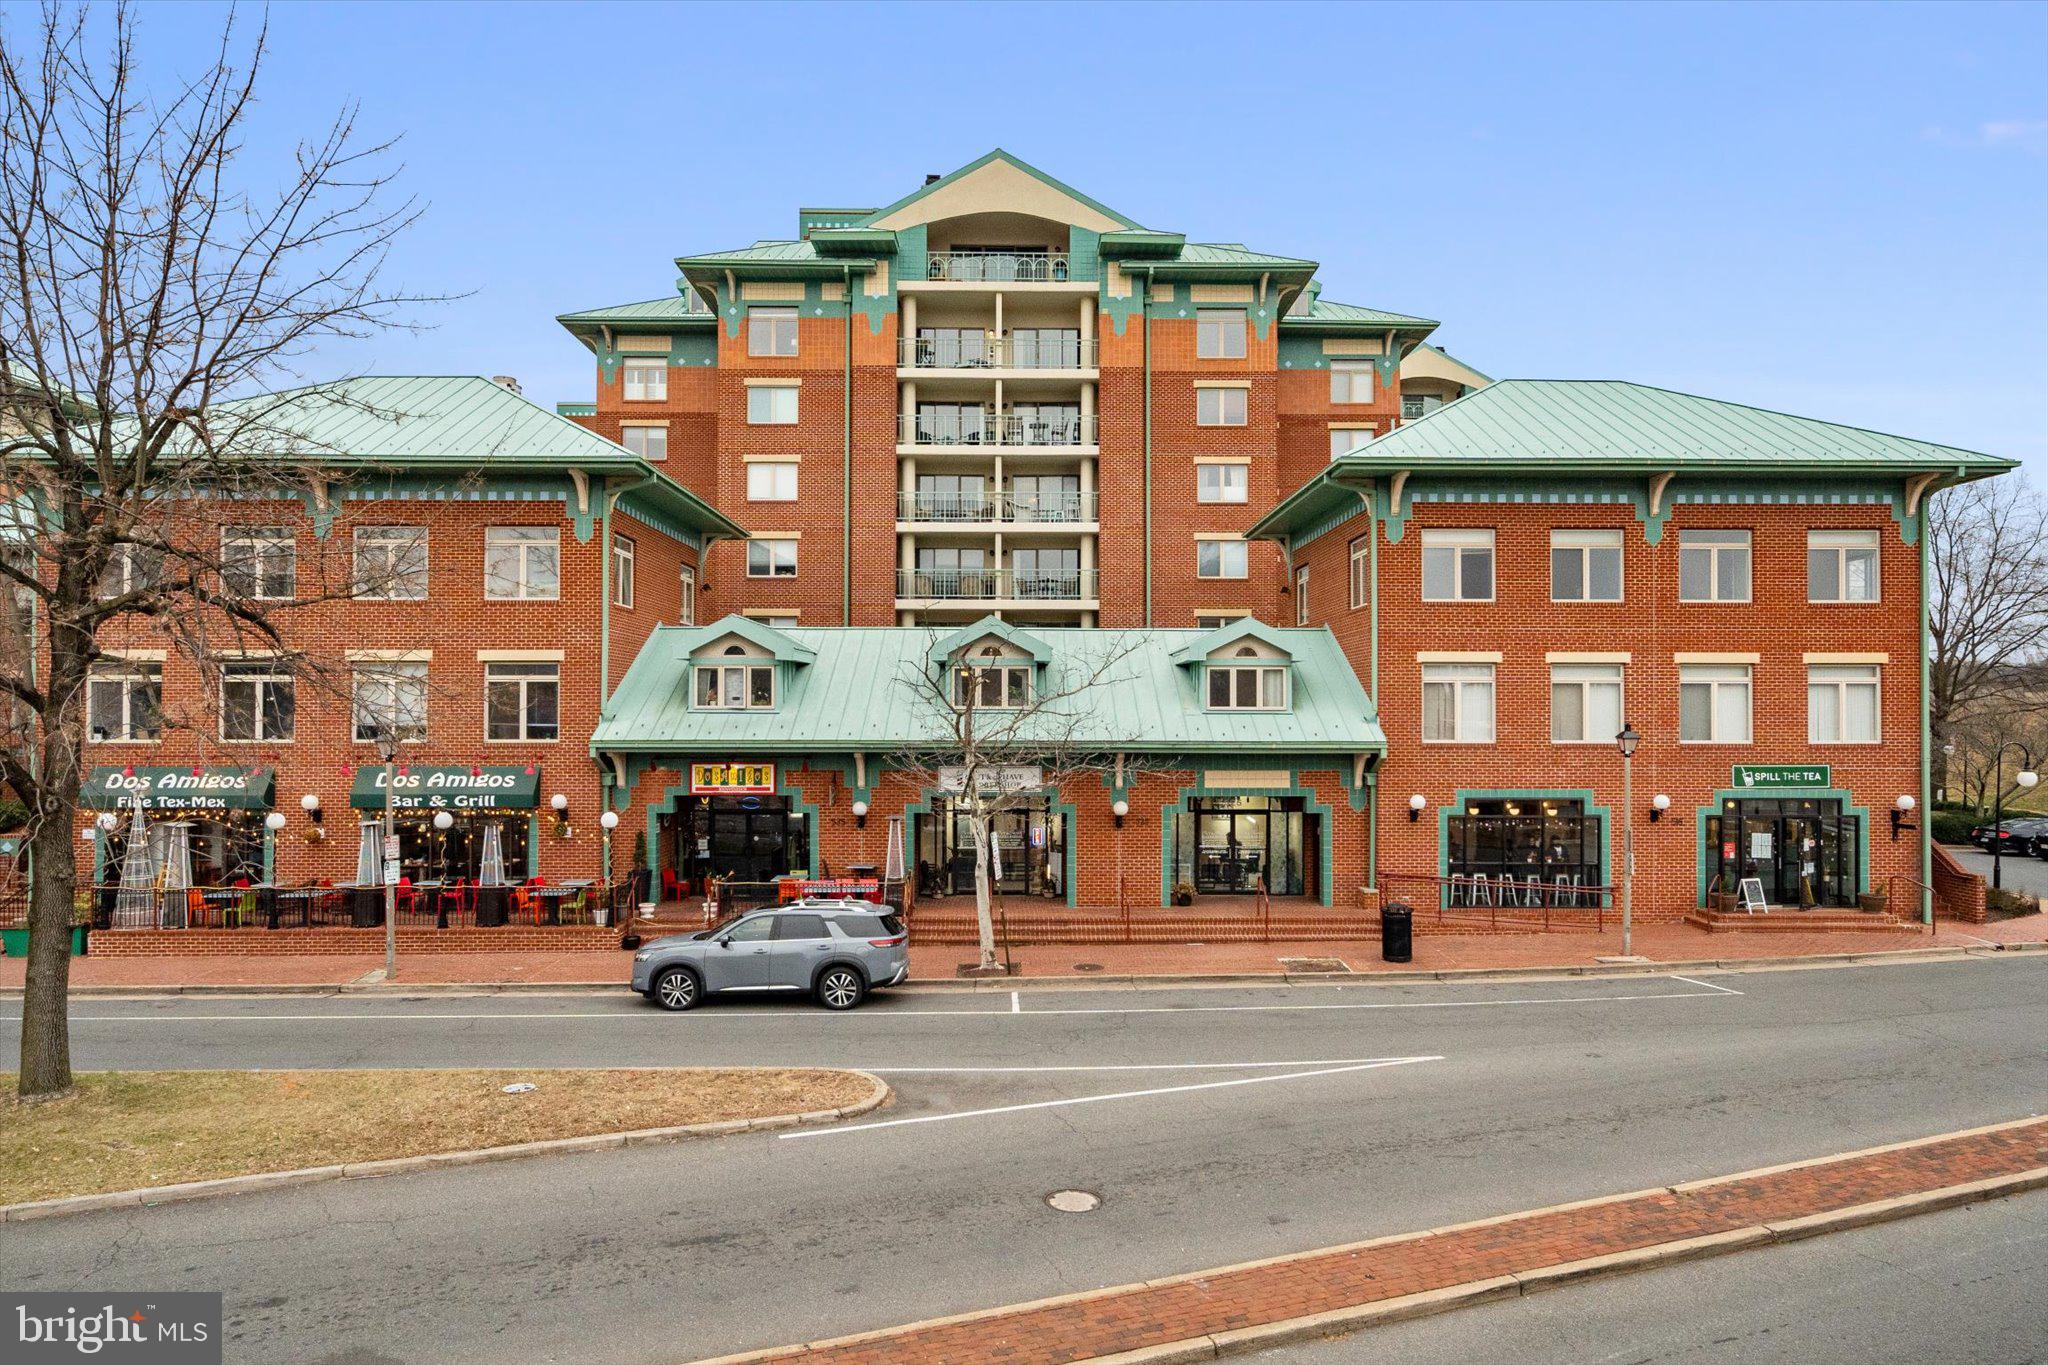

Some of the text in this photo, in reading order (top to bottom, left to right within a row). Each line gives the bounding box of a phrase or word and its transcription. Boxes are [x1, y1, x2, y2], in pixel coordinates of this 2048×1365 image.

[105, 772, 248, 789] Dos Amigos
[375, 772, 515, 788] Dos Amigos
[1754, 772, 1821, 781] SPILL THE TEA
[157, 796, 225, 808] Tex-Mex
[429, 795, 448, 807] &
[454, 795, 495, 807] Grill
